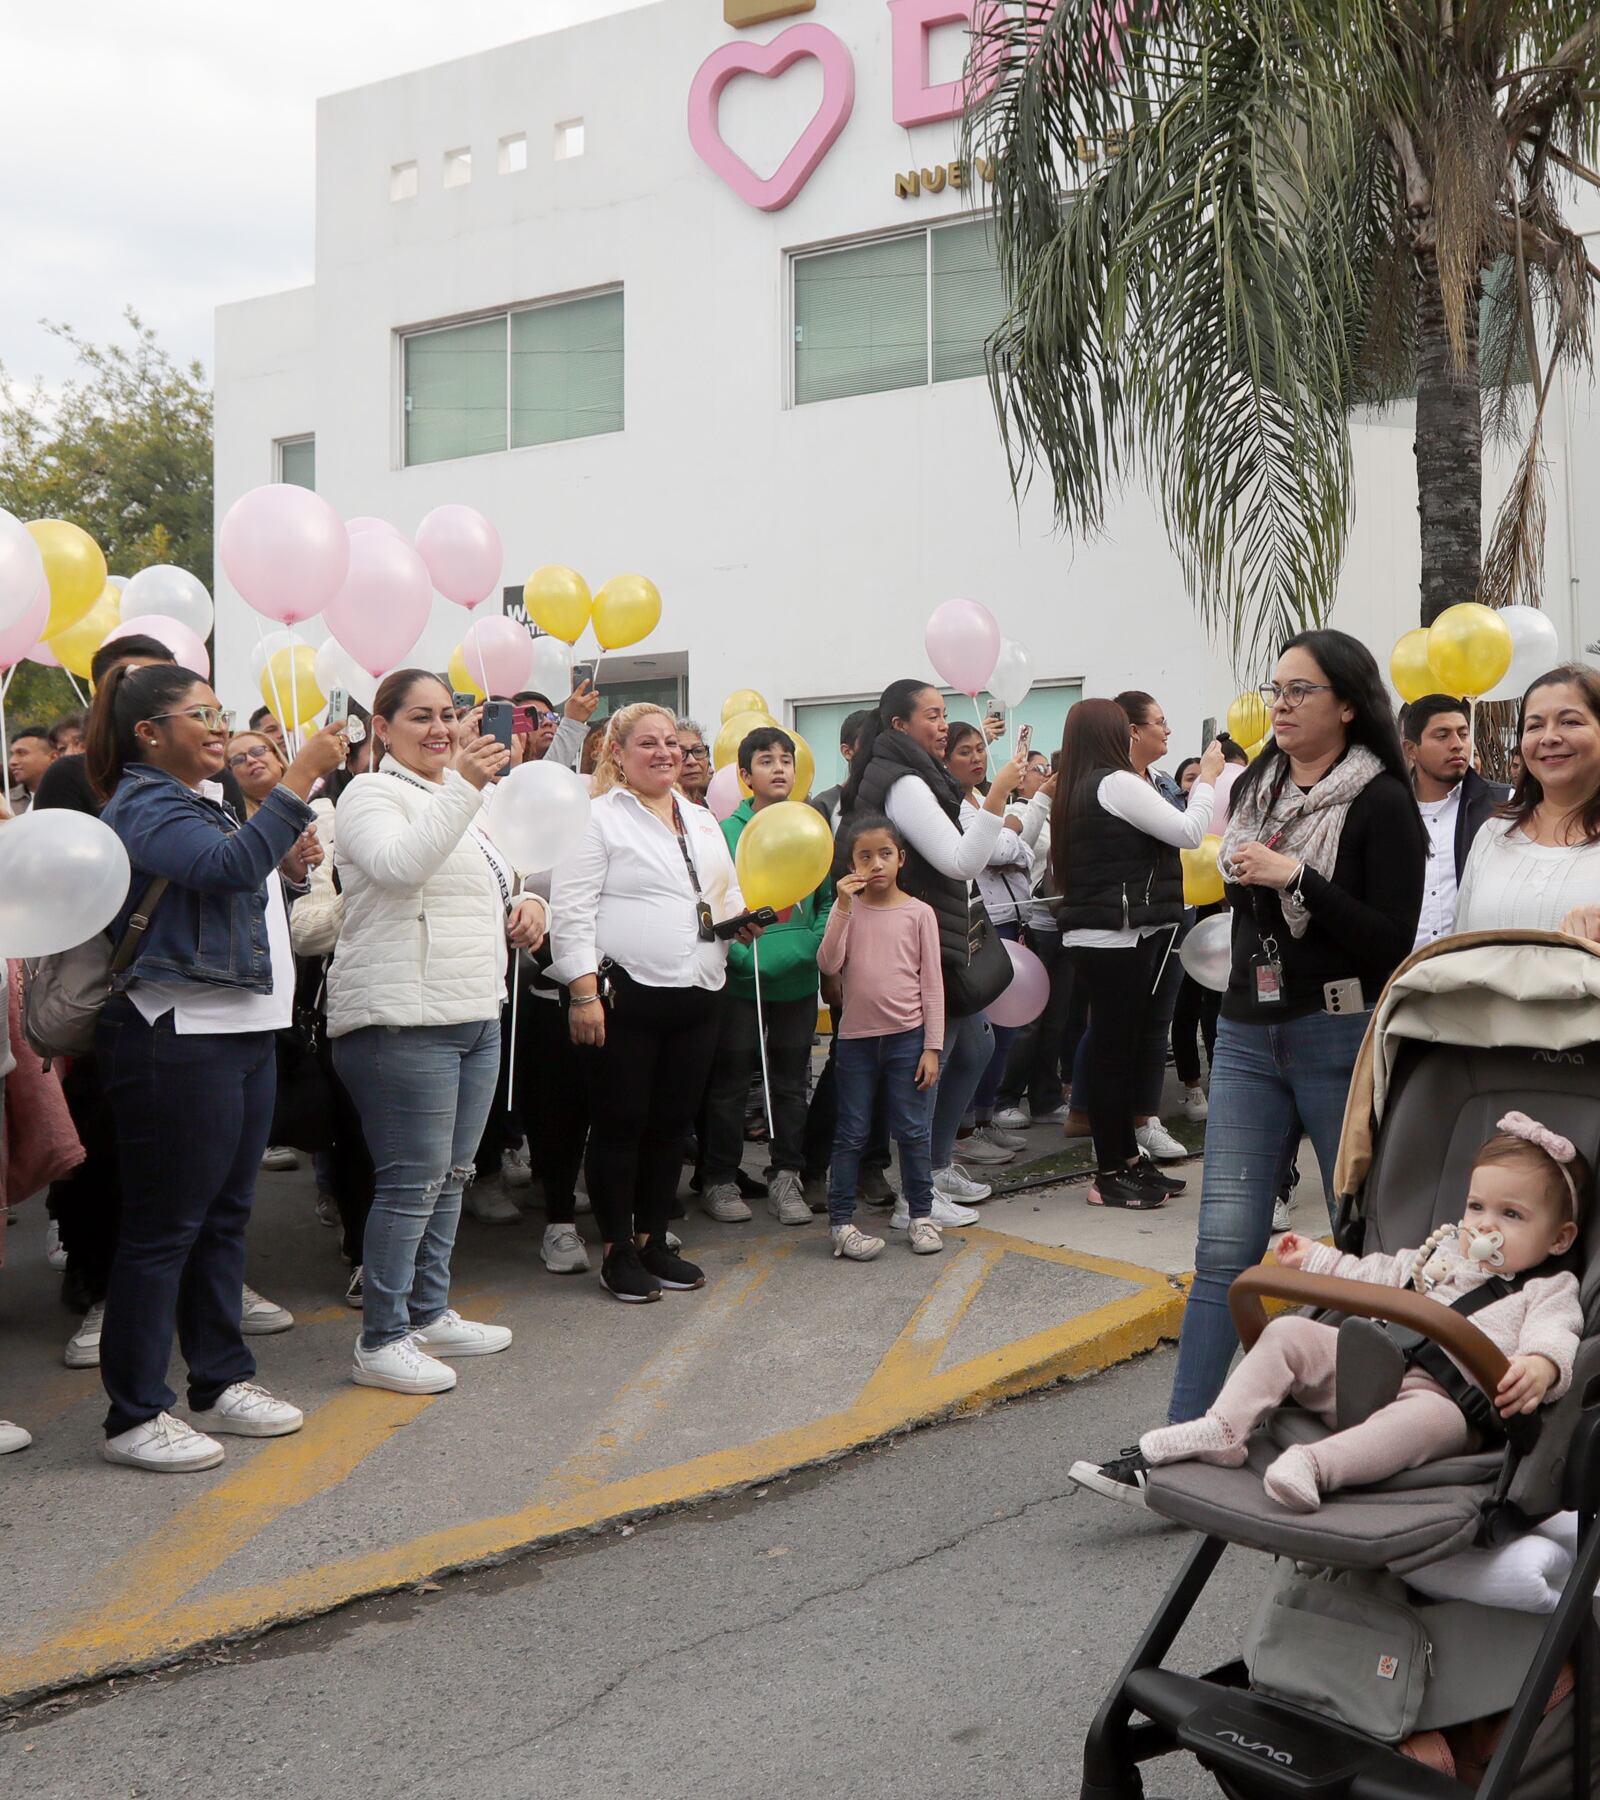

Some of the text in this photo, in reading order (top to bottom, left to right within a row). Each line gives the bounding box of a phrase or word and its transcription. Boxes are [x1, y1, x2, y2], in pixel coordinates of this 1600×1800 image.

[894, 151, 1008, 199] NUEV
[1532, 1050, 1585, 1065] nuna
[1216, 1730, 1293, 1765] nuna
